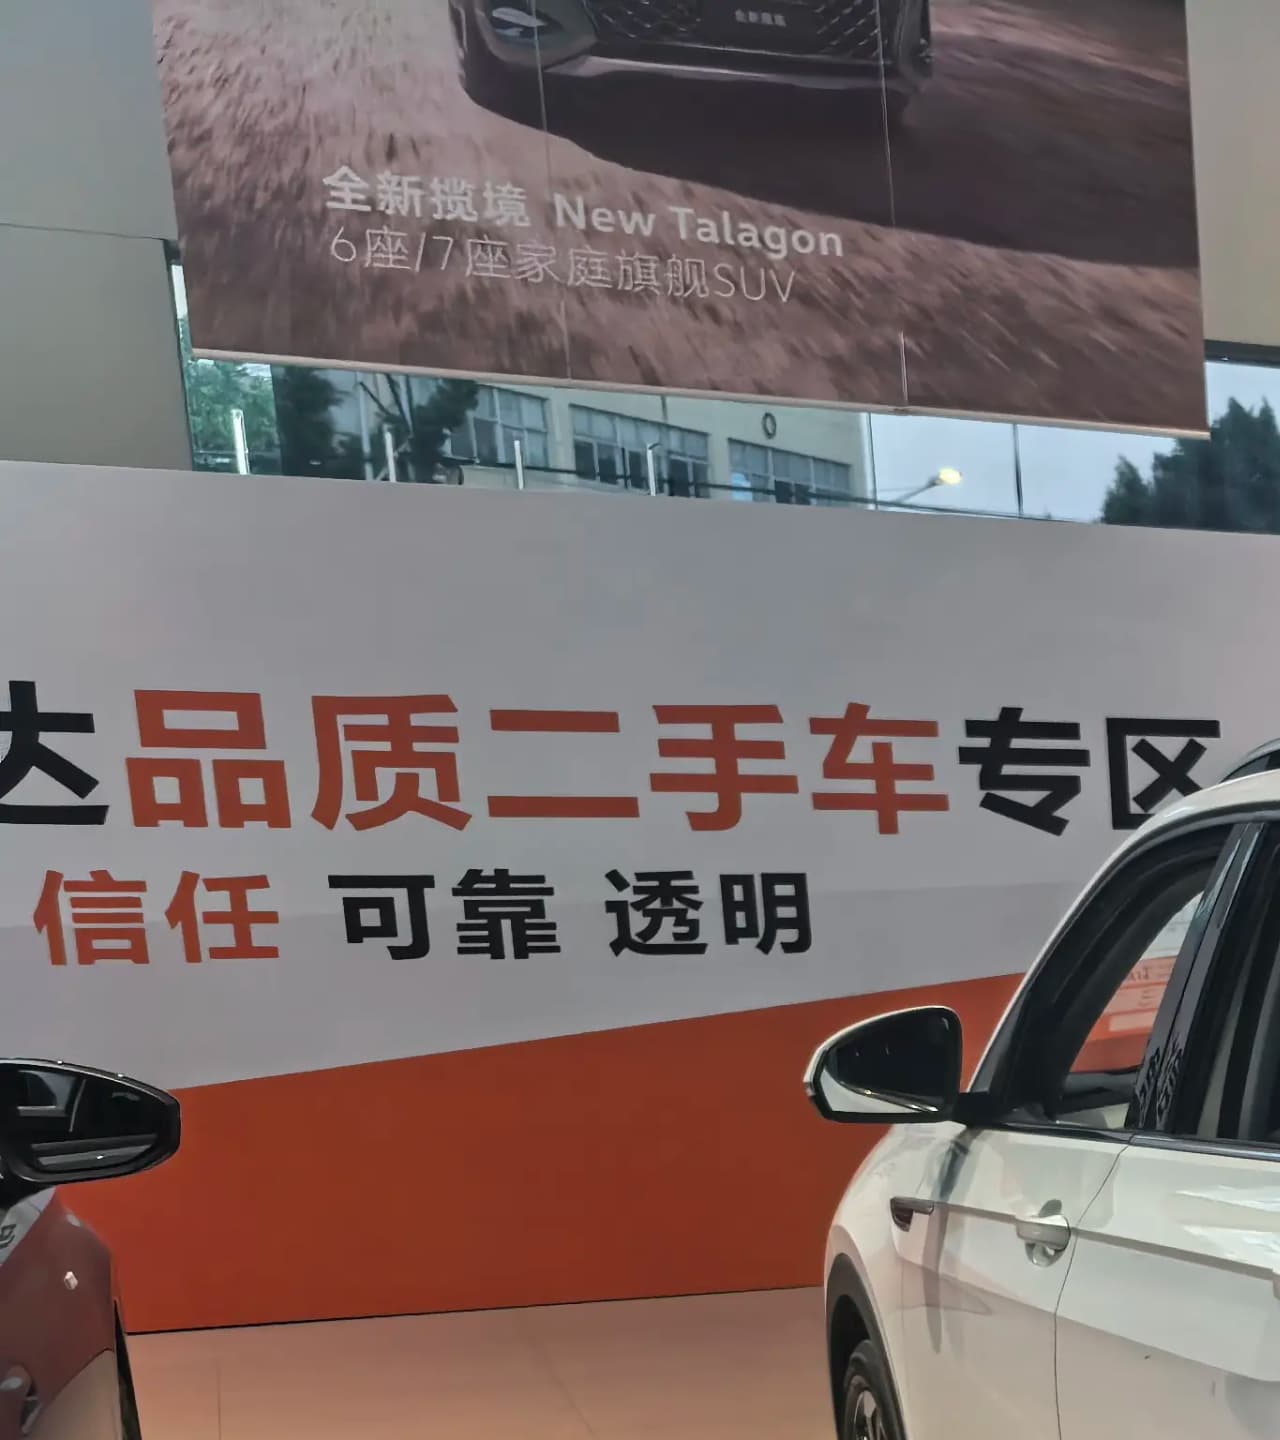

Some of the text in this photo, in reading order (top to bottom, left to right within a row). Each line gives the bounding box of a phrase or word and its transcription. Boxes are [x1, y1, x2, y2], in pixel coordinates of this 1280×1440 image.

[322, 164, 844, 260] 全新揽境 New Talagon
[33, 867, 813, 966] 信任 可靠 透明
